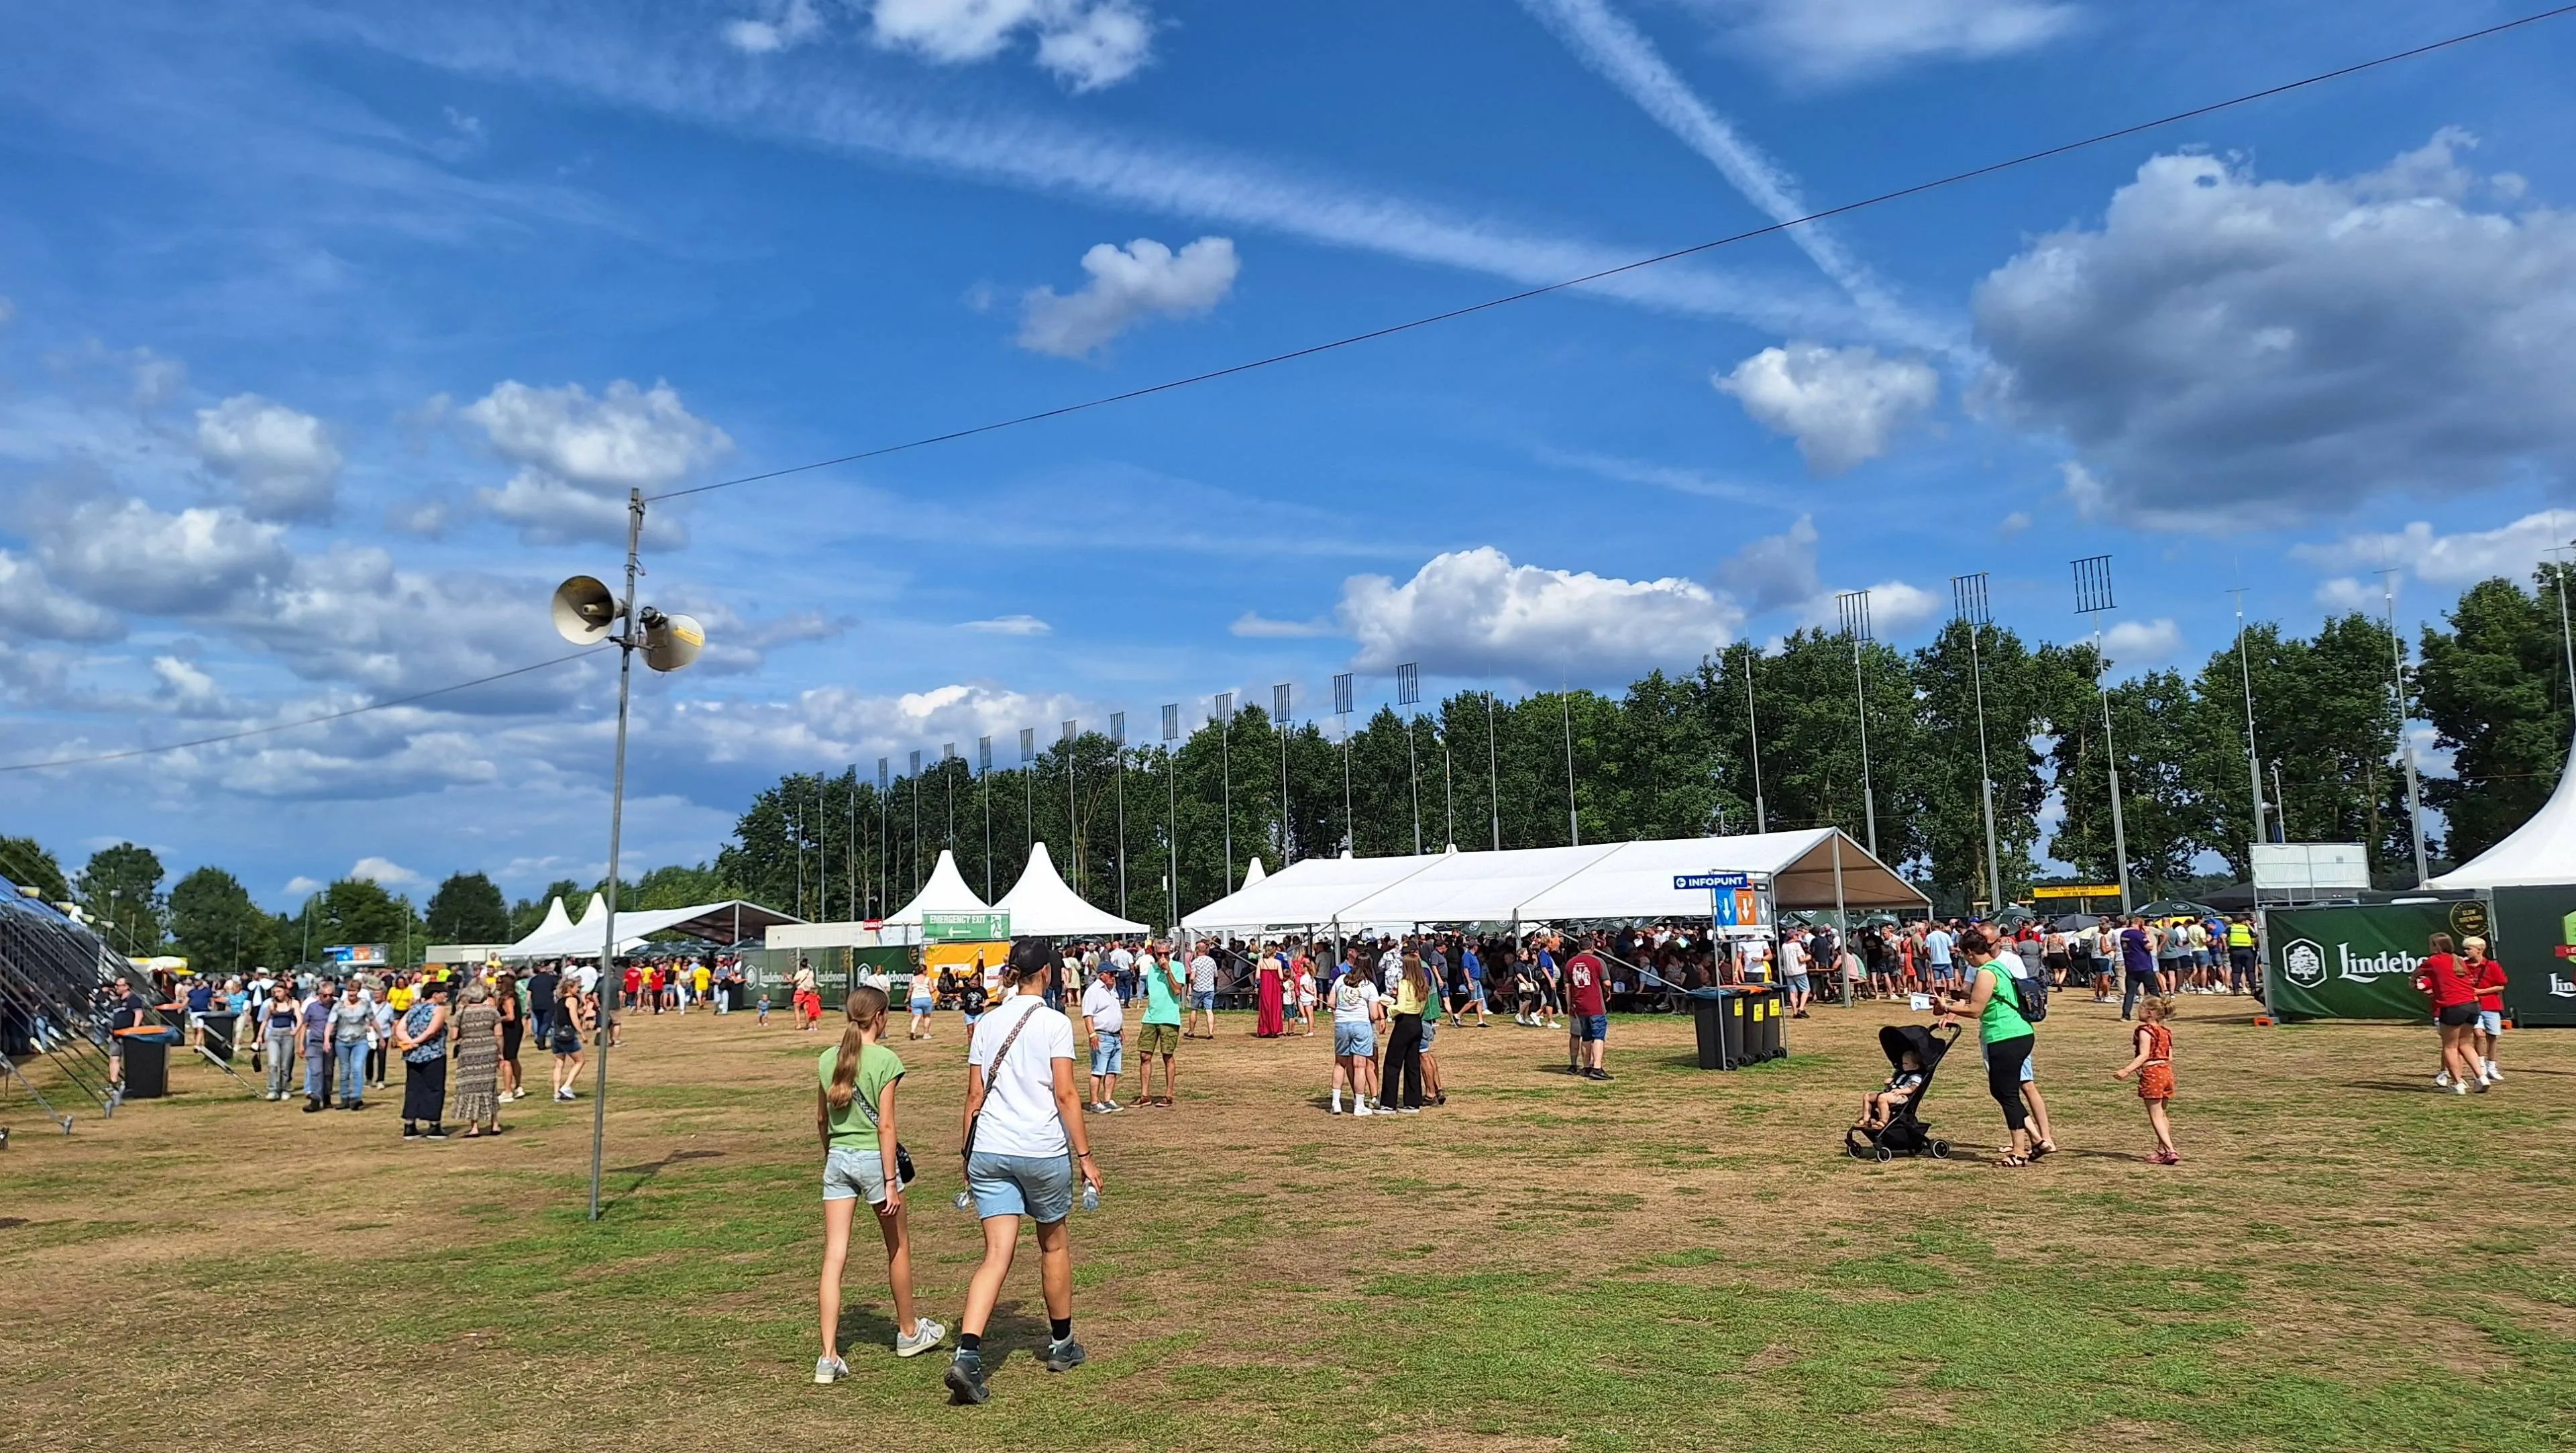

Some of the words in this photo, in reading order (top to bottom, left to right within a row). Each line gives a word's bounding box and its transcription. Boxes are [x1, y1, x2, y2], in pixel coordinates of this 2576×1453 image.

[1688, 876, 1743, 887] INFOPUNT
[930, 914, 970, 924] EMERGENCY
[971, 914, 986, 924] EXIT
[2337, 942, 2469, 983] Lindeb
[758, 967, 792, 987] Lindebo
[815, 965, 847, 987] Lindeboom
